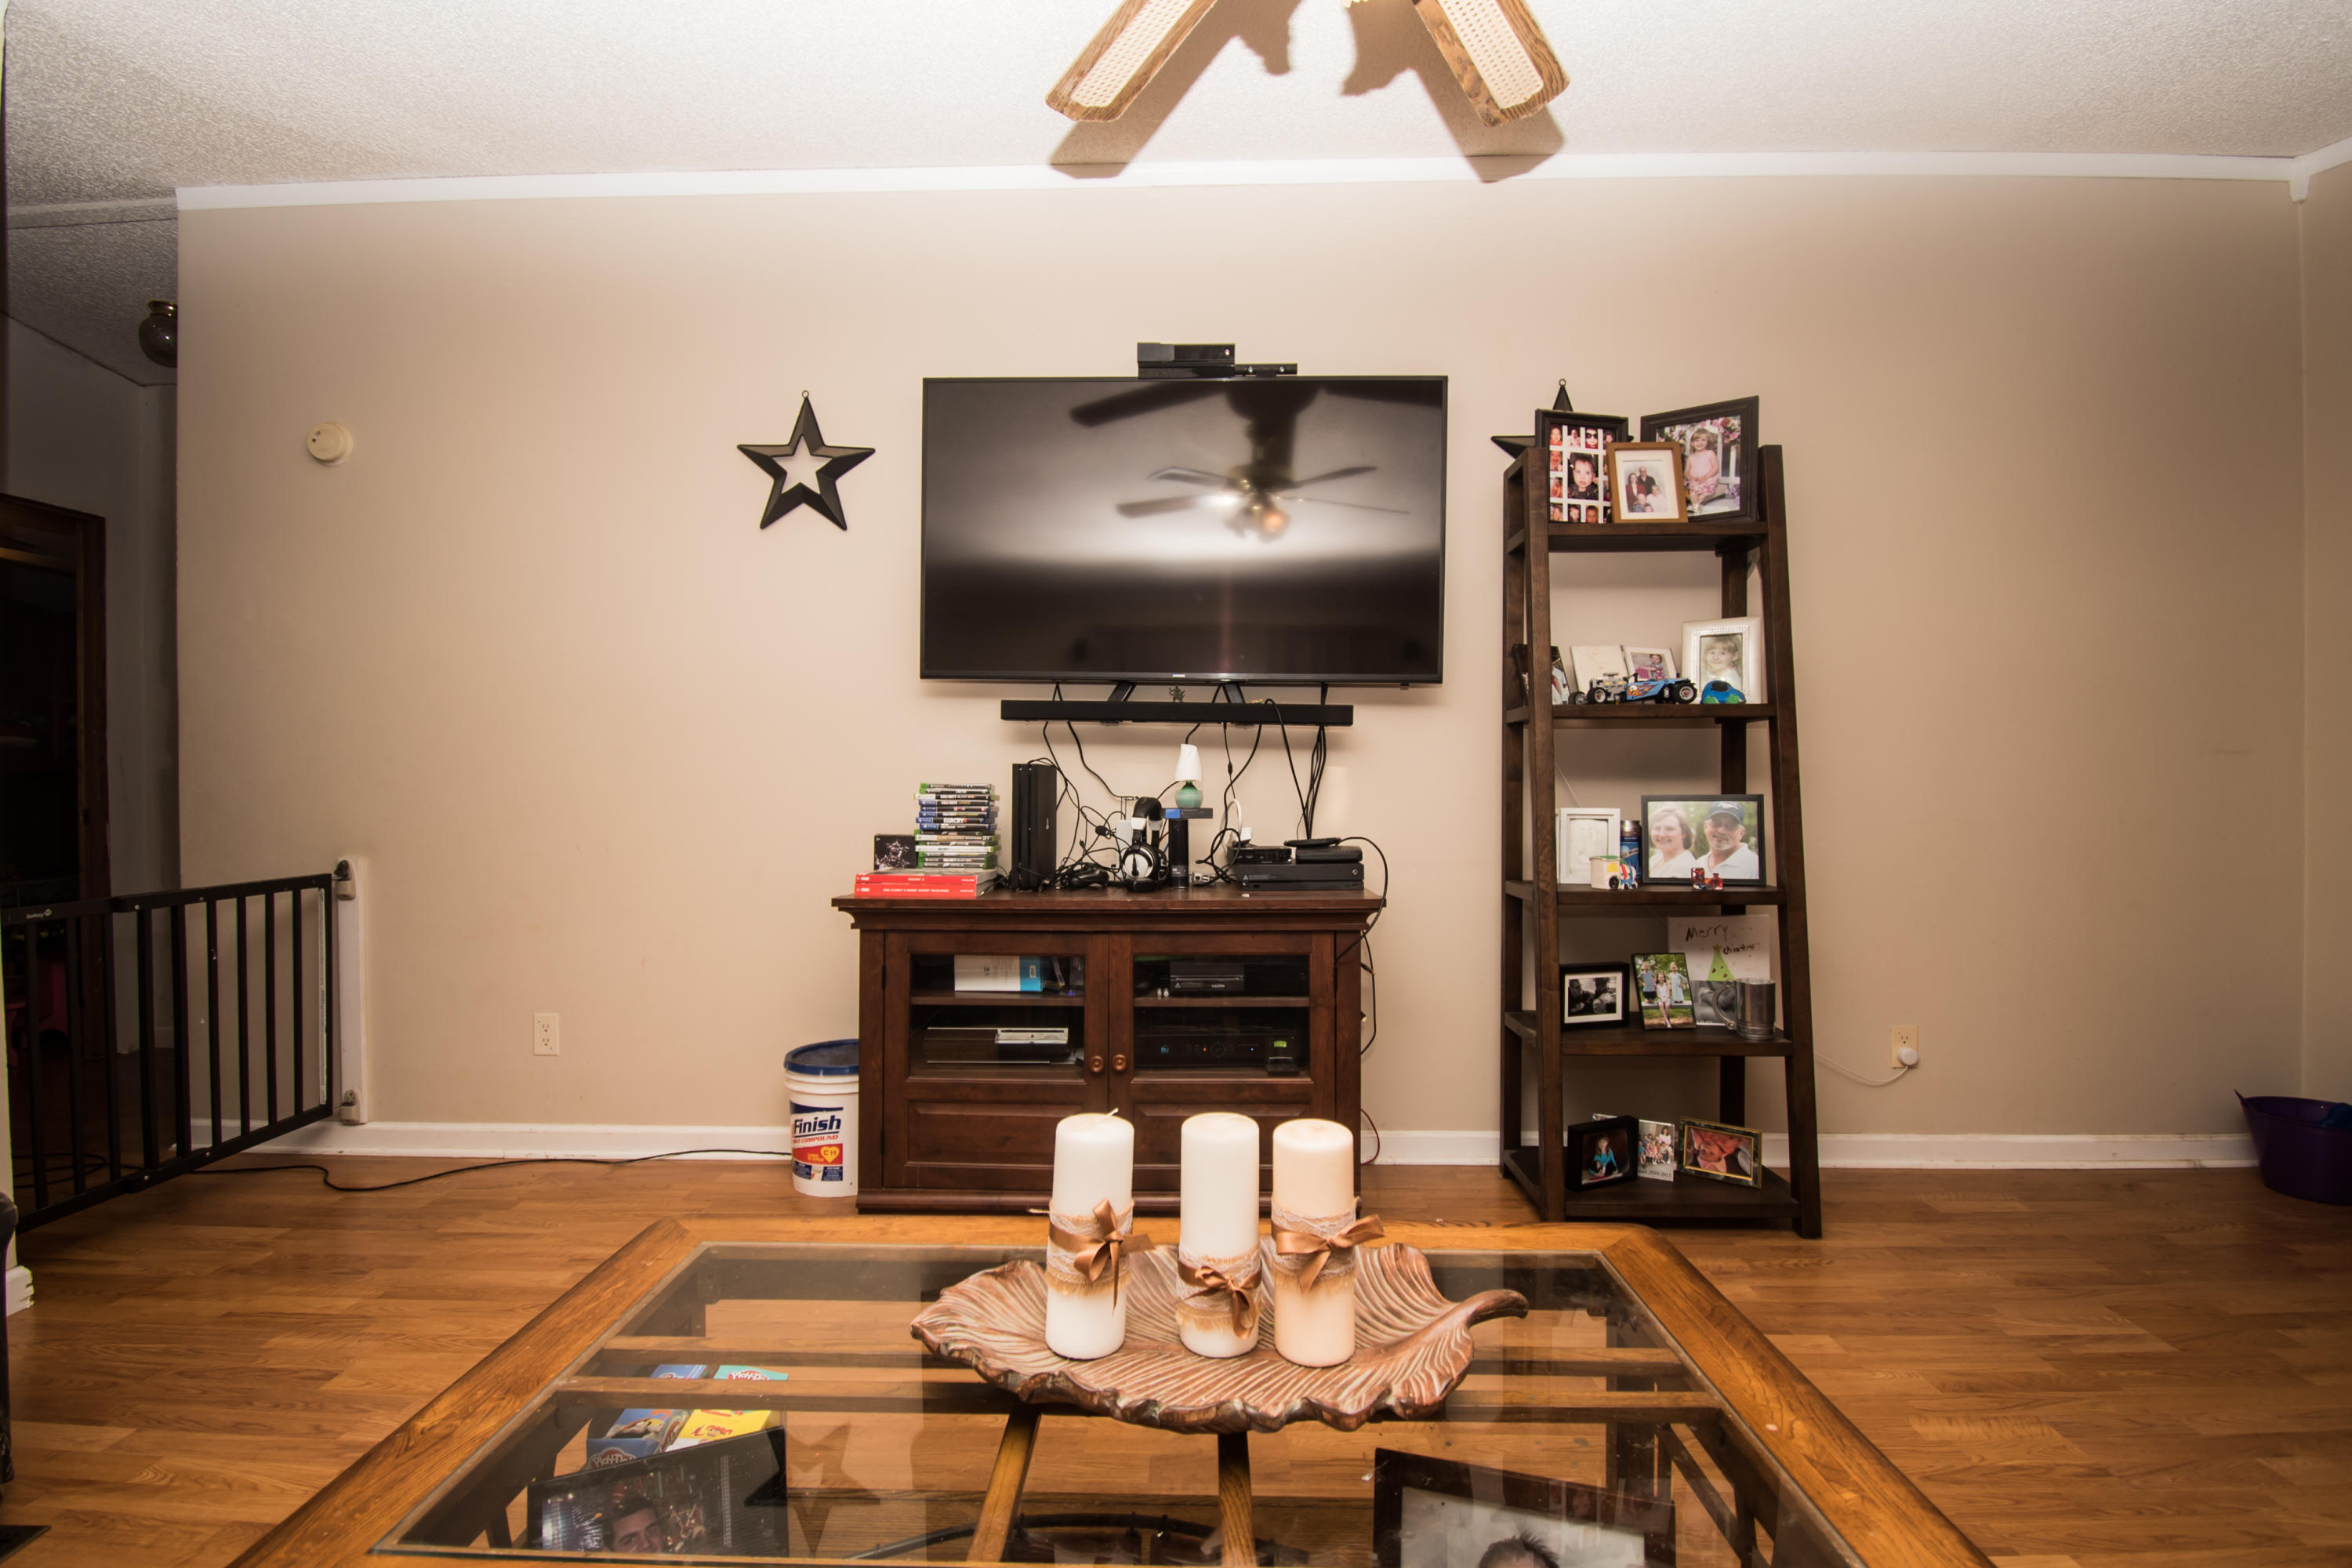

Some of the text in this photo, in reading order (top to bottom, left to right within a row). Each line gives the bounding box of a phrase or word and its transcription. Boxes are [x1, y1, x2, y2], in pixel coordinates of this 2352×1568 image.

[1686, 924, 1728, 941] Merry
[793, 1115, 841, 1134] Finish
[592, 1453, 633, 1468] Play-D
